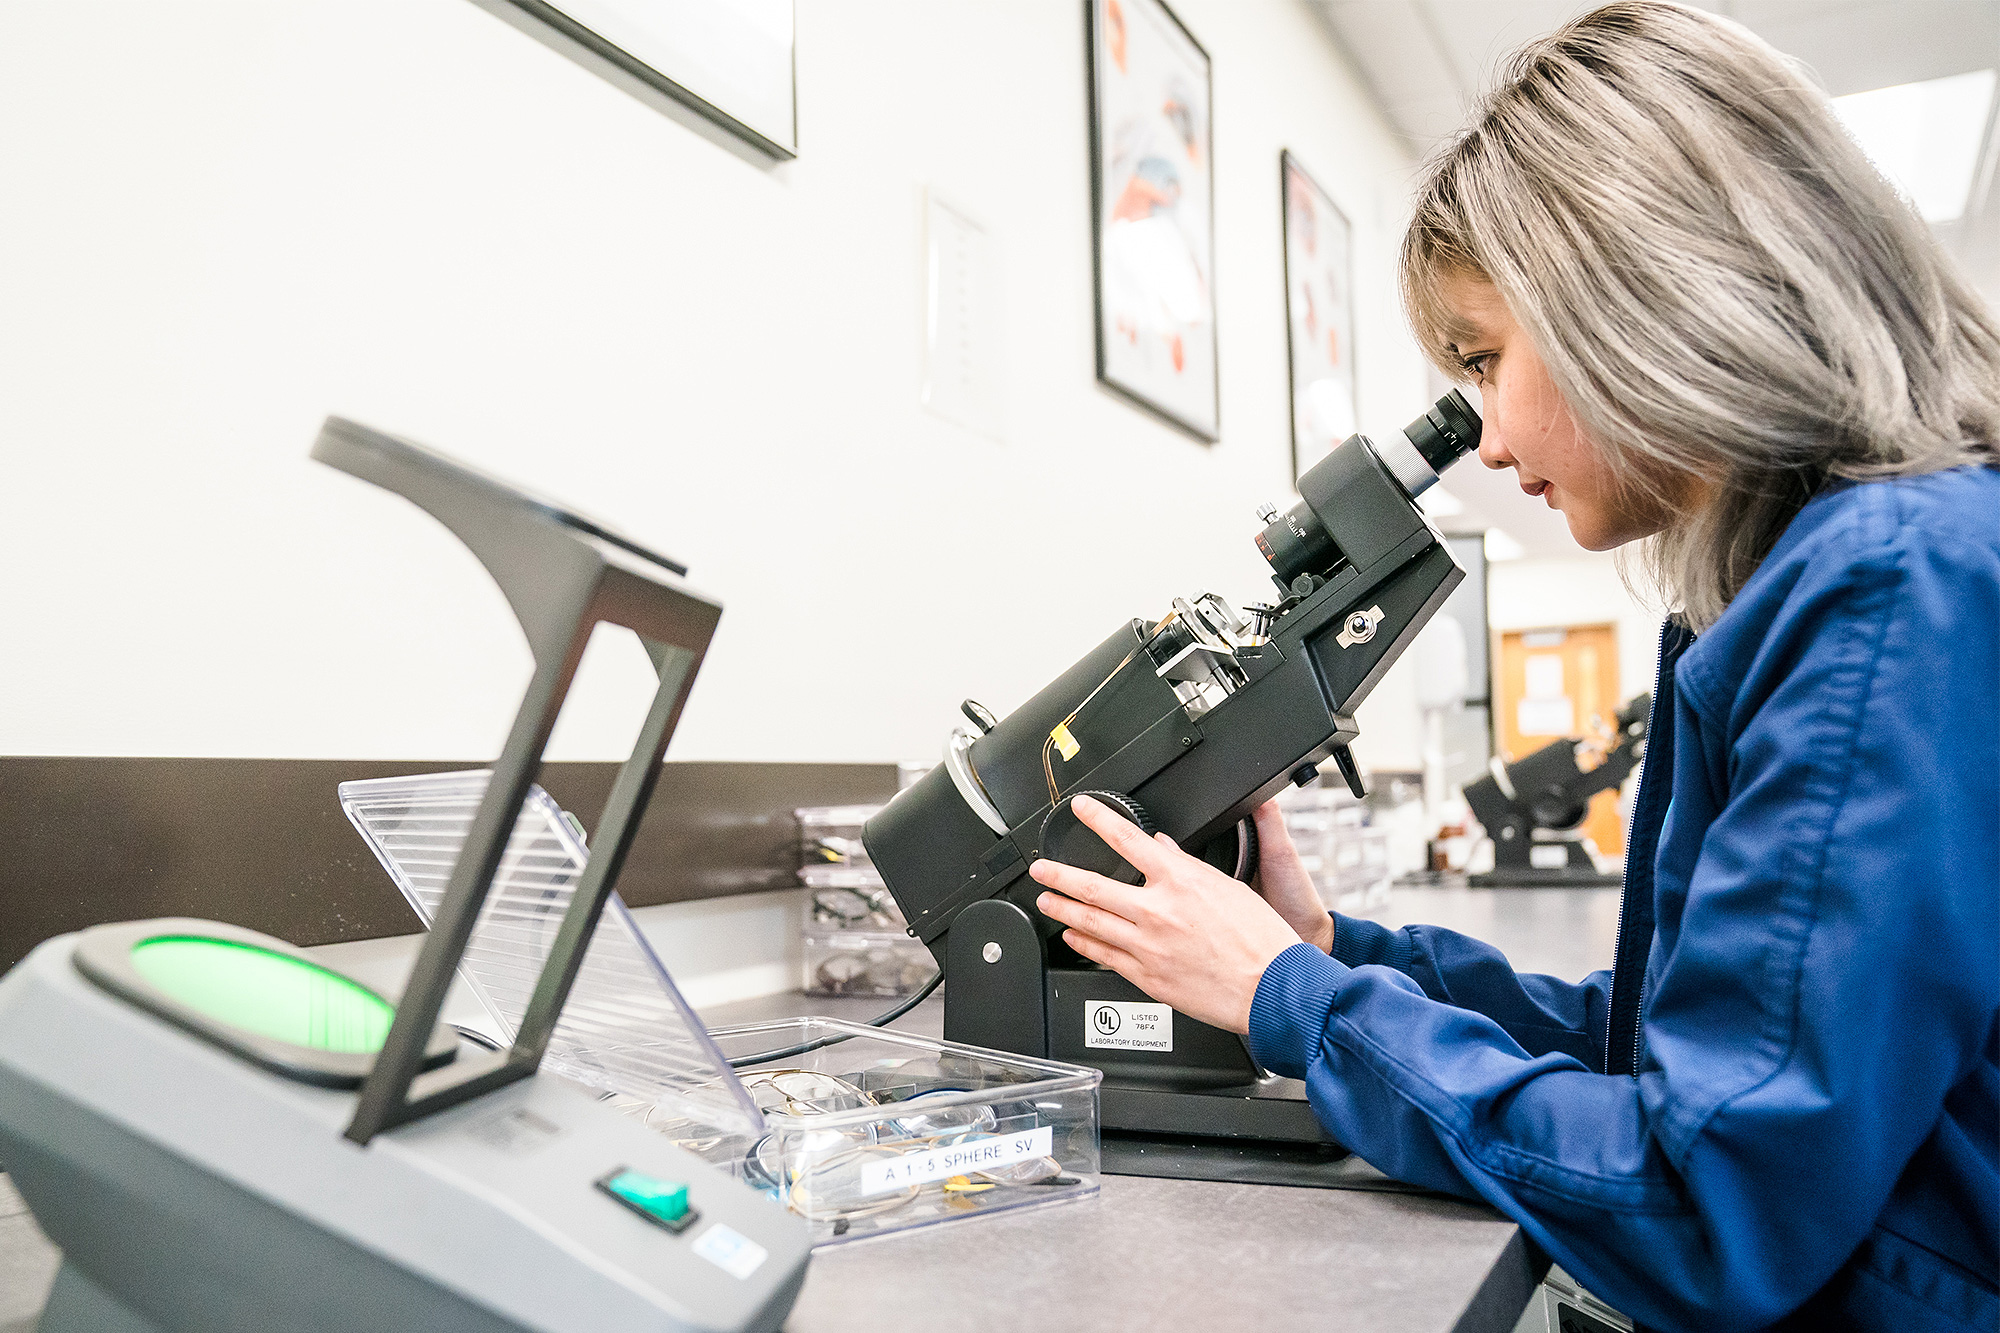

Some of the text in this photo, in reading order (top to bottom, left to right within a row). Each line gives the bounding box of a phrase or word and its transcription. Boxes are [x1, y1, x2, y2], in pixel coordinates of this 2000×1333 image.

[1099, 1011, 1115, 1030] UL
[1131, 1014, 1159, 1022] LISTED
[1135, 1023, 1155, 1031] 78F4
[1090, 1037, 1168, 1048] LABORATORY EQUIPMENT
[885, 1167, 896, 1181] A
[943, 1144, 1002, 1168] SPHERE
[1015, 1138, 1034, 1154] SV
